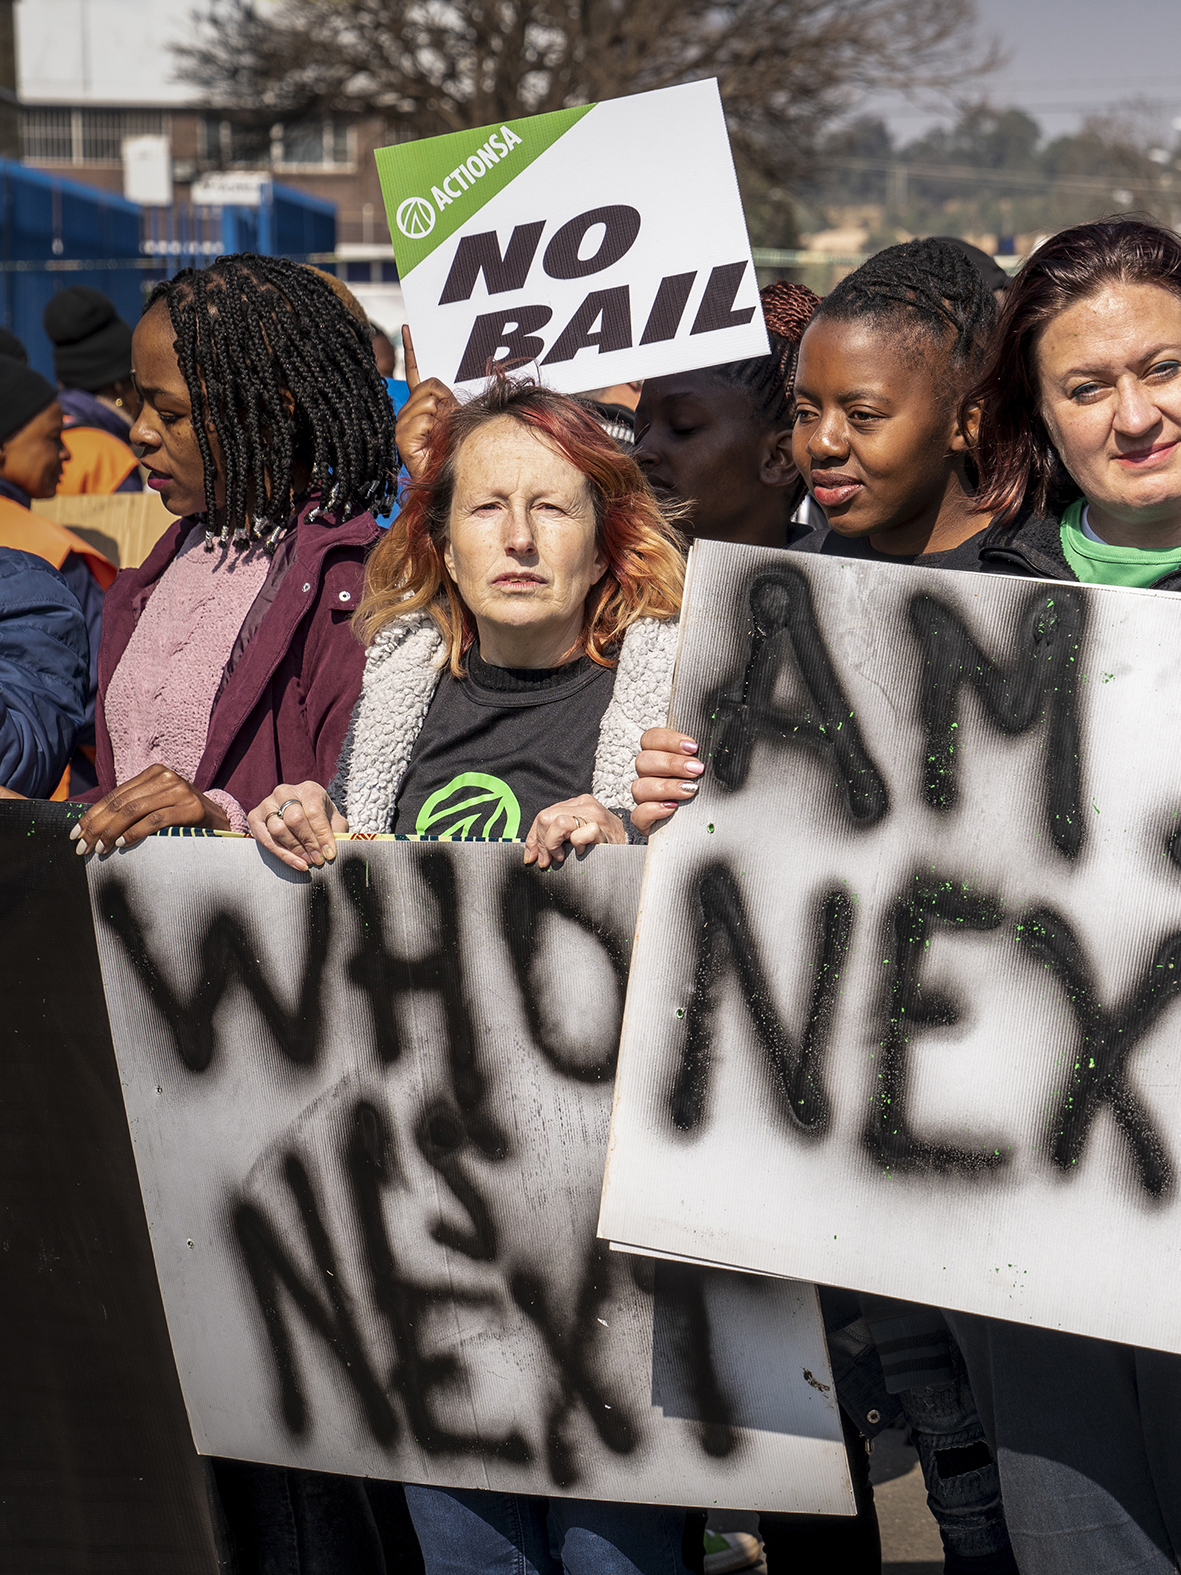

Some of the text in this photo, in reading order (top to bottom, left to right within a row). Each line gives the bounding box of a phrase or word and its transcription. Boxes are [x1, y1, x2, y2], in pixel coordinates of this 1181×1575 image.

[430, 125, 523, 212] ACTIONSA
[438, 204, 642, 306] NO
[454, 260, 757, 384] BAIL
[706, 565, 1088, 858] AM
[97, 853, 630, 1108] WHO
[230, 1150, 764, 1490] NEXT
